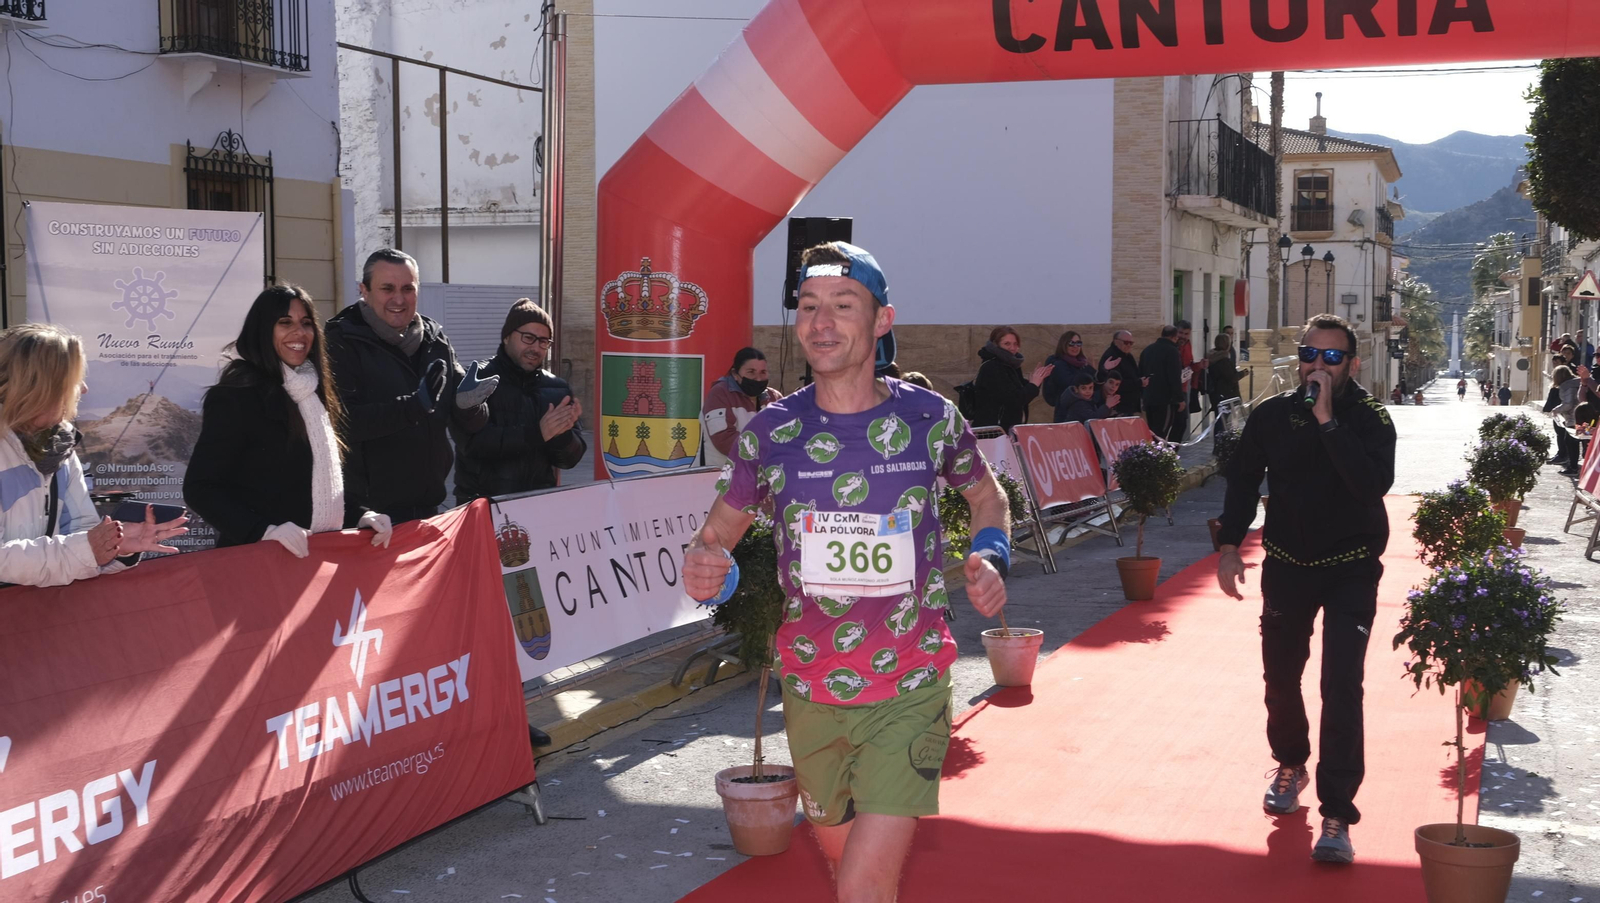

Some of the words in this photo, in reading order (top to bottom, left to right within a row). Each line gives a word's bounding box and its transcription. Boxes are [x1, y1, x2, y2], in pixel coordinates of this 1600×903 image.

[165, 228, 184, 240] UN
[188, 228, 242, 242] FUTURO
[92, 241, 114, 254] SIN
[119, 243, 200, 257] ADICCIONES
[97, 333, 140, 349] Nuevo
[147, 334, 194, 350] Rumbo
[95, 463, 174, 474] @NrumboAsoc
[870, 465, 885, 475] LOS
[886, 461, 927, 473] SALTABOJAS
[1045, 448, 1093, 482] VEOLIA
[818, 513, 830, 522] IV
[833, 513, 860, 523] CxM
[814, 525, 827, 534] LA
[830, 523, 875, 536] PÓLVORA
[825, 540, 893, 574] 366
[555, 543, 689, 616] CANTO
[266, 652, 471, 771] TEAMERGY
